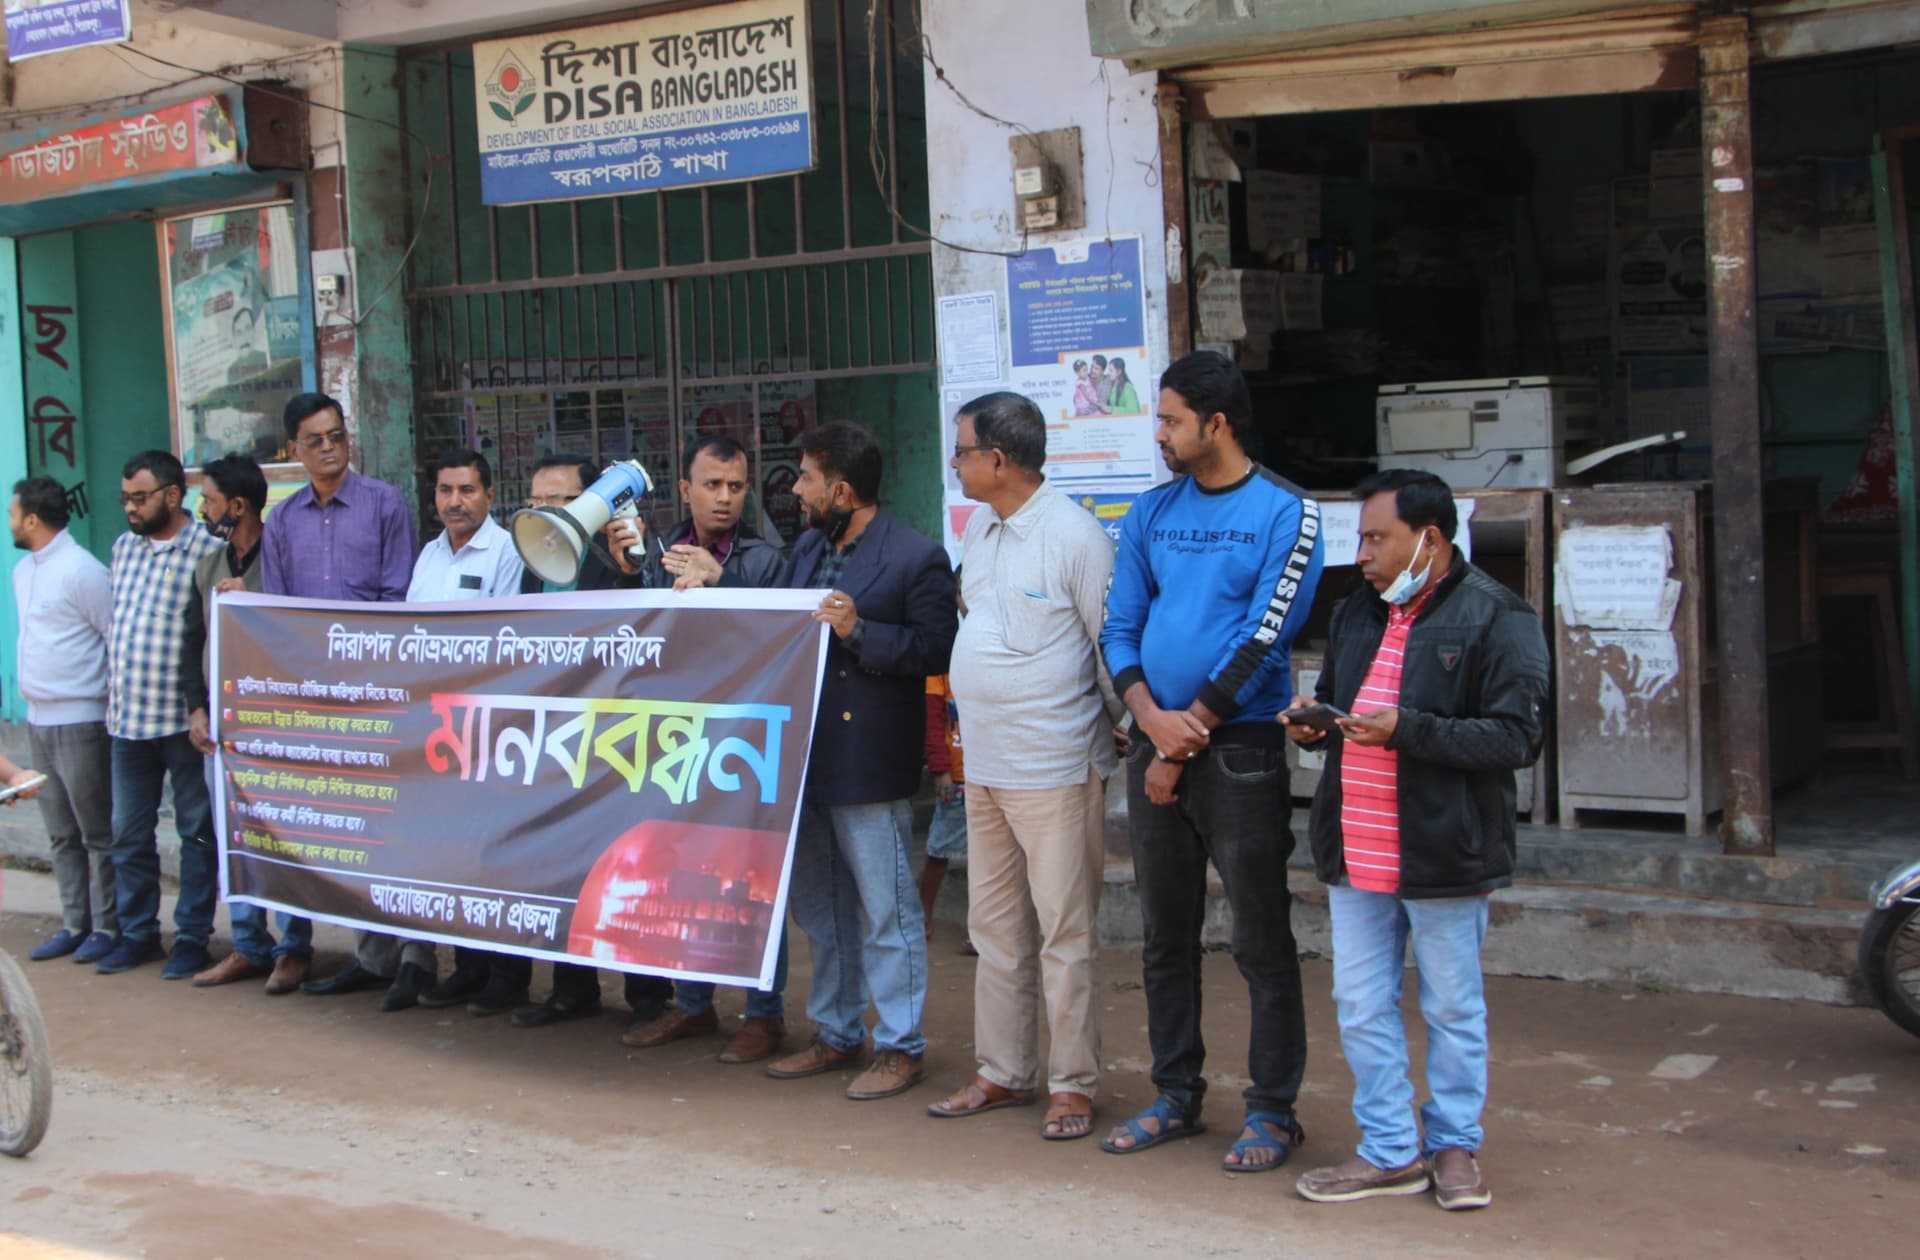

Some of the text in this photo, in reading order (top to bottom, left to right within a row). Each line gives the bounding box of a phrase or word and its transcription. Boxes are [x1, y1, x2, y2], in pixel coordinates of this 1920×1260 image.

[541, 16, 794, 87] দিশা বাংলাদেশ
[543, 80, 643, 124] DISA
[651, 59, 798, 110] BANGLADESH
[487, 96, 798, 148] DEVELOPMENT OF IDEAL SOCIAL ASSOCIATION IN BANGLADESH
[550, 149, 729, 187] স্বরূপকাঠি শাখা
[1152, 529, 1257, 545] HOLLISTER
[1253, 498, 1320, 645] HOLLISTER
[328, 623, 395, 662] নিরাপদ
[399, 624, 492, 665] নৌভ্রমনের
[496, 625, 588, 667] নিশ্চয়তার
[425, 693, 792, 805] মানববন্ধন
[459, 895, 504, 928] স্বরূপ
